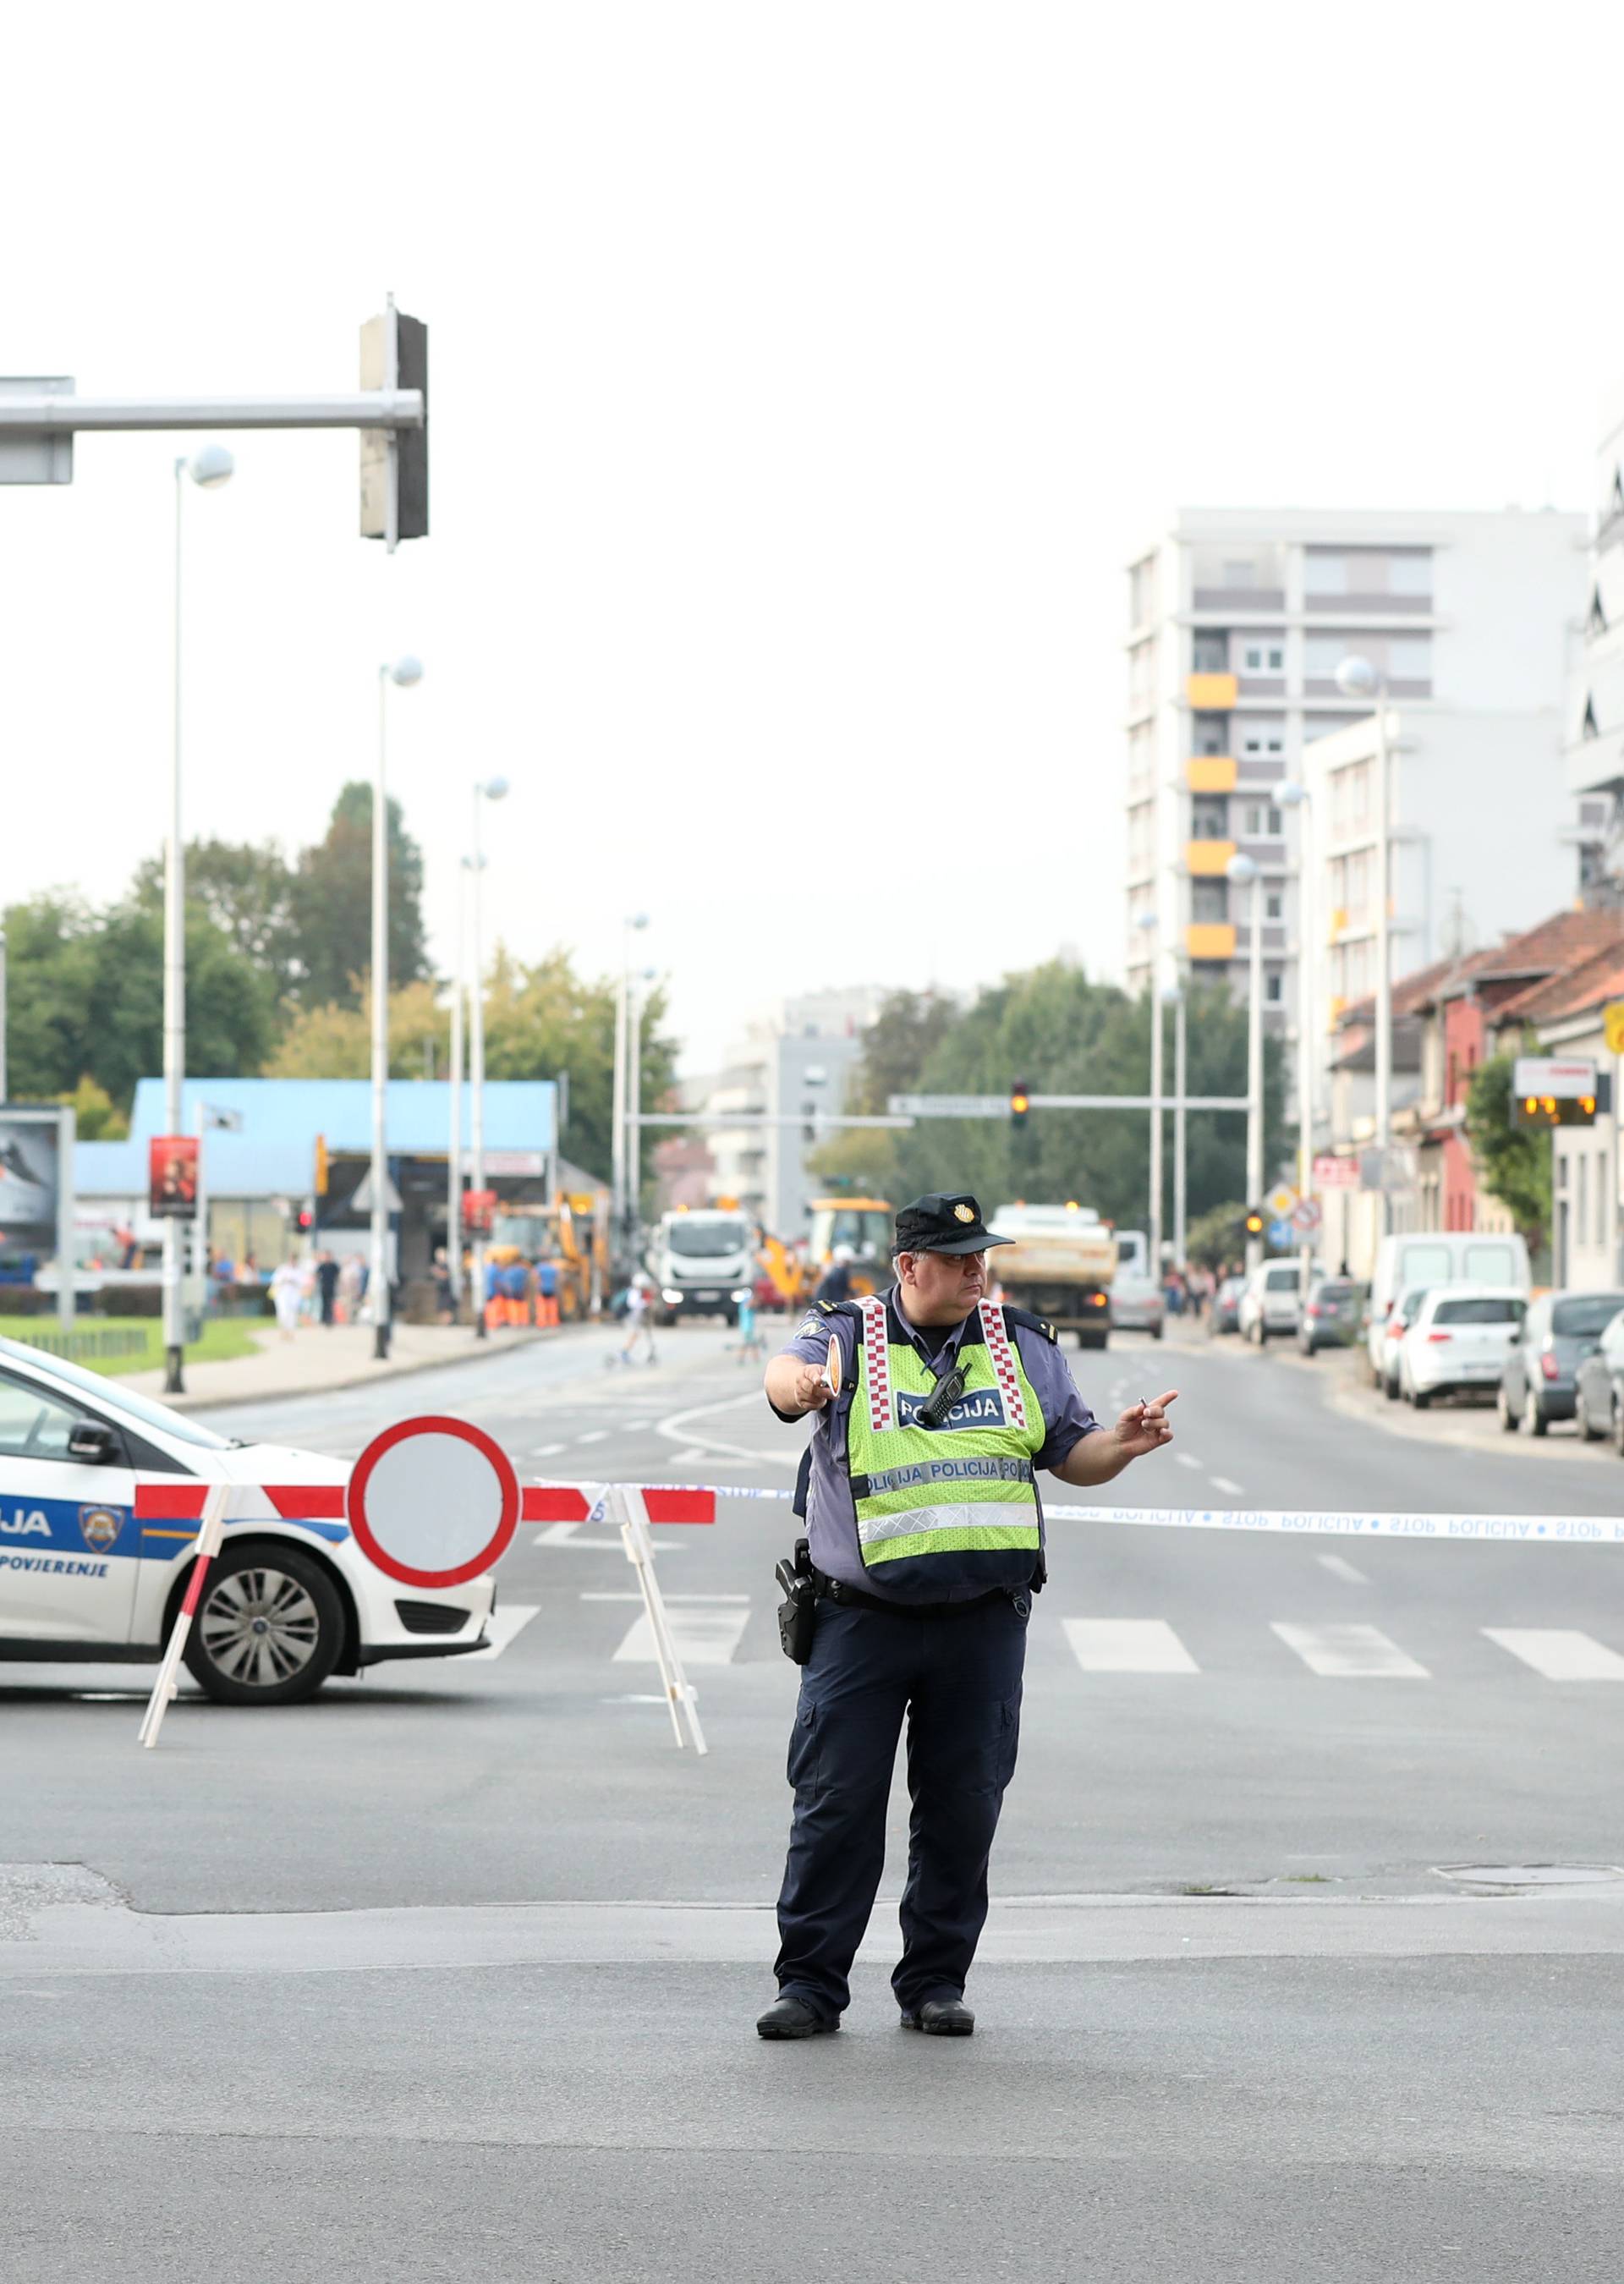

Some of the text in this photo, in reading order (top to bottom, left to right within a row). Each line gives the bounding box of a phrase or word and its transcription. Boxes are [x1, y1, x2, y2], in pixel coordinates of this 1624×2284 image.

[931, 1461, 997, 1478] POLICIJA
[0, 1508, 52, 1537] JA
[0, 1555, 109, 1578] POVJERENJE
